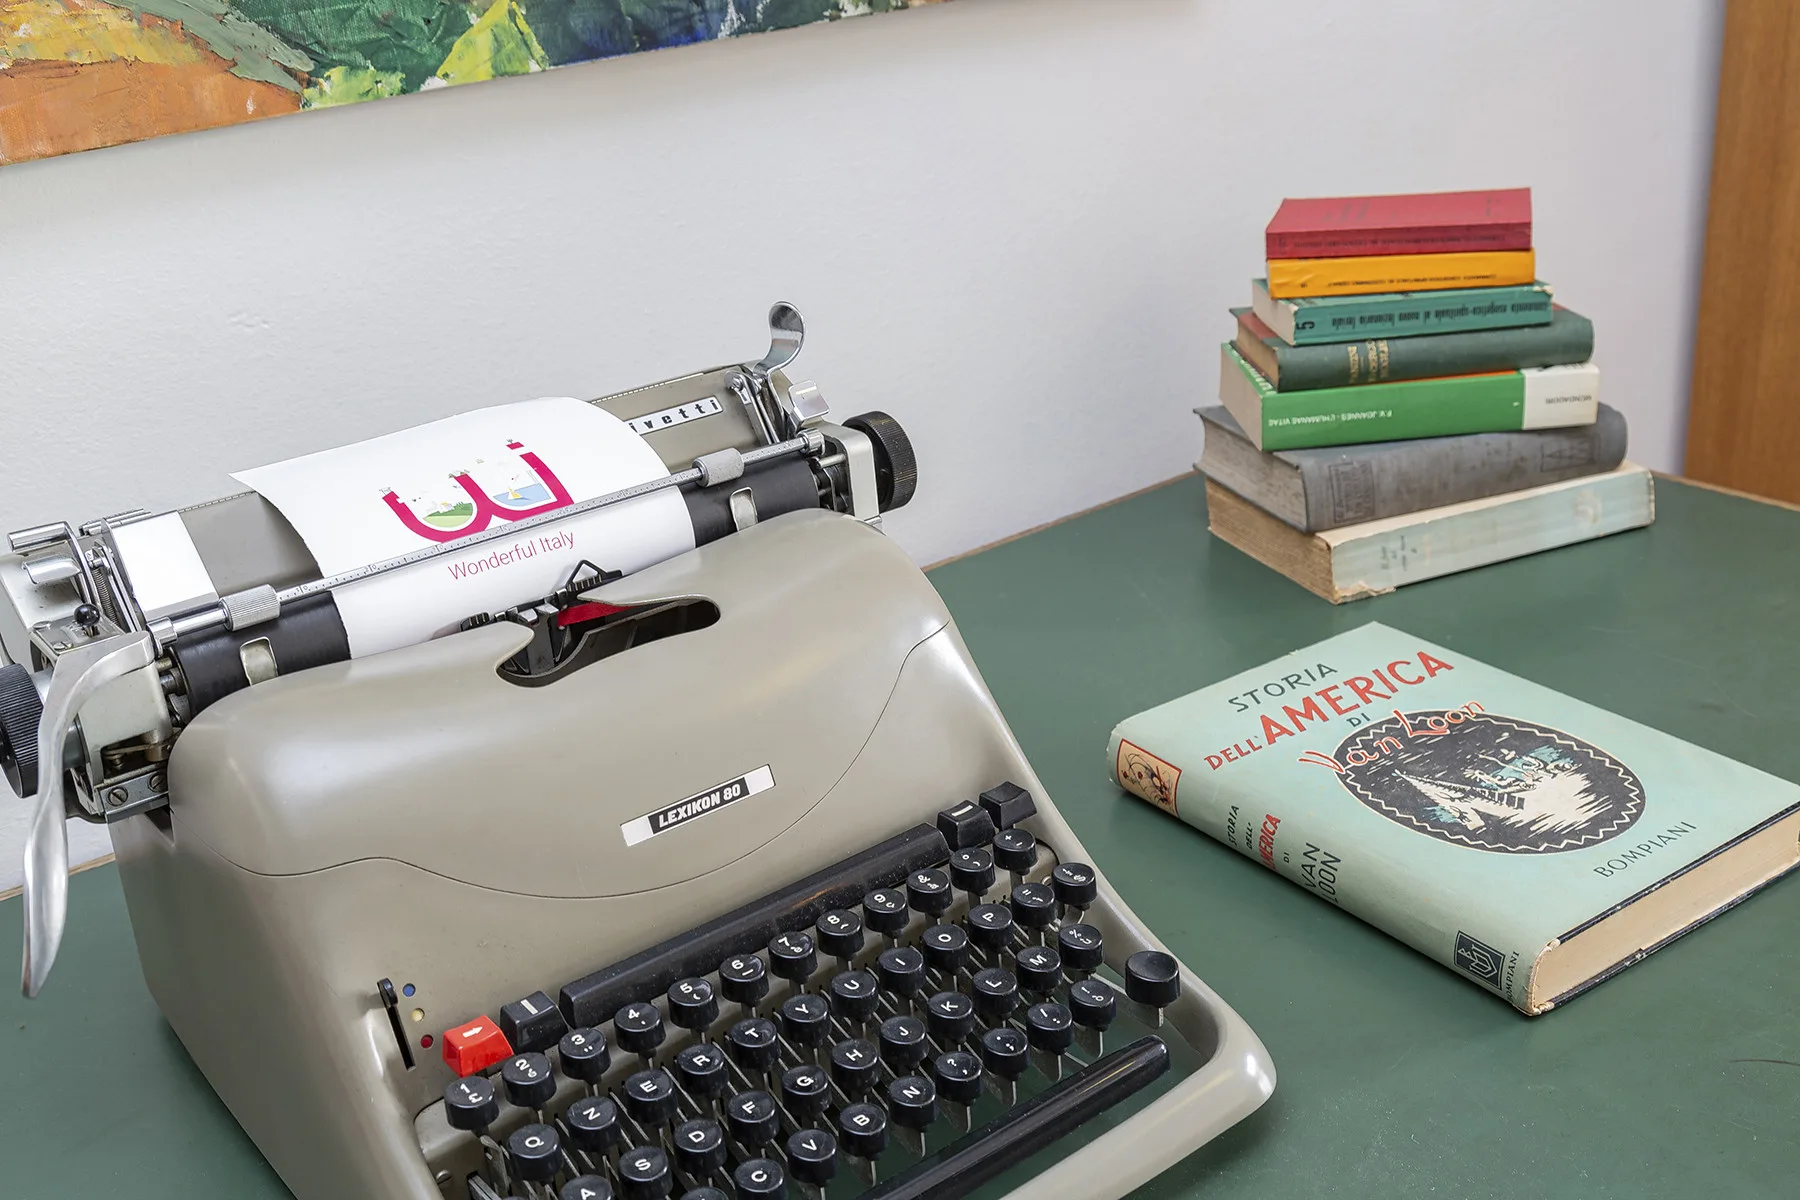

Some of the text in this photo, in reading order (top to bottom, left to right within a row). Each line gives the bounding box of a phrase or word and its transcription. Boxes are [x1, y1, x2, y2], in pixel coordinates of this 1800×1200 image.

[628, 400, 718, 433] ivetti
[447, 531, 575, 580] Wonderful Italy
[1228, 663, 1338, 713] STORIA
[1346, 712, 1371, 727] DI
[1297, 701, 1485, 775] Van Loon
[658, 783, 741, 828] LEXIKON 80
[1228, 805, 1239, 846] STORIA
[1593, 821, 1697, 878] BOMPIANI
[1283, 852, 1289, 863] DI
[1301, 842, 1320, 888] VAN
[874, 894, 886, 903] 9
[827, 915, 840, 924] 8
[982, 912, 994, 922] P
[778, 936, 790, 946] 7
[938, 933, 951, 943] O
[731, 959, 744, 970] 6
[895, 958, 905, 966] I
[1029, 954, 1047, 966] M
[679, 983, 693, 994] 5
[844, 979, 860, 990] U
[985, 979, 1002, 988] L
[795, 1004, 809, 1014] Y
[940, 1001, 958, 1012] K
[628, 1009, 640, 1019] 4
[745, 1027, 759, 1038] T
[900, 1026, 909, 1036] J
[571, 1034, 585, 1045] 3
[693, 1054, 711, 1066] R
[845, 1048, 863, 1061] H
[515, 1059, 530, 1071] 2
[640, 1080, 657, 1093] E
[796, 1075, 814, 1087] G
[460, 1083, 470, 1093] 1
[902, 1086, 920, 1098] N
[742, 1101, 756, 1114] F
[853, 1114, 870, 1126] B
[525, 1136, 544, 1147] Q
[688, 1130, 705, 1143] D
[801, 1139, 817, 1151] V
[635, 1159, 651, 1171] S
[751, 1170, 768, 1182] C
[581, 1188, 596, 1200] A
